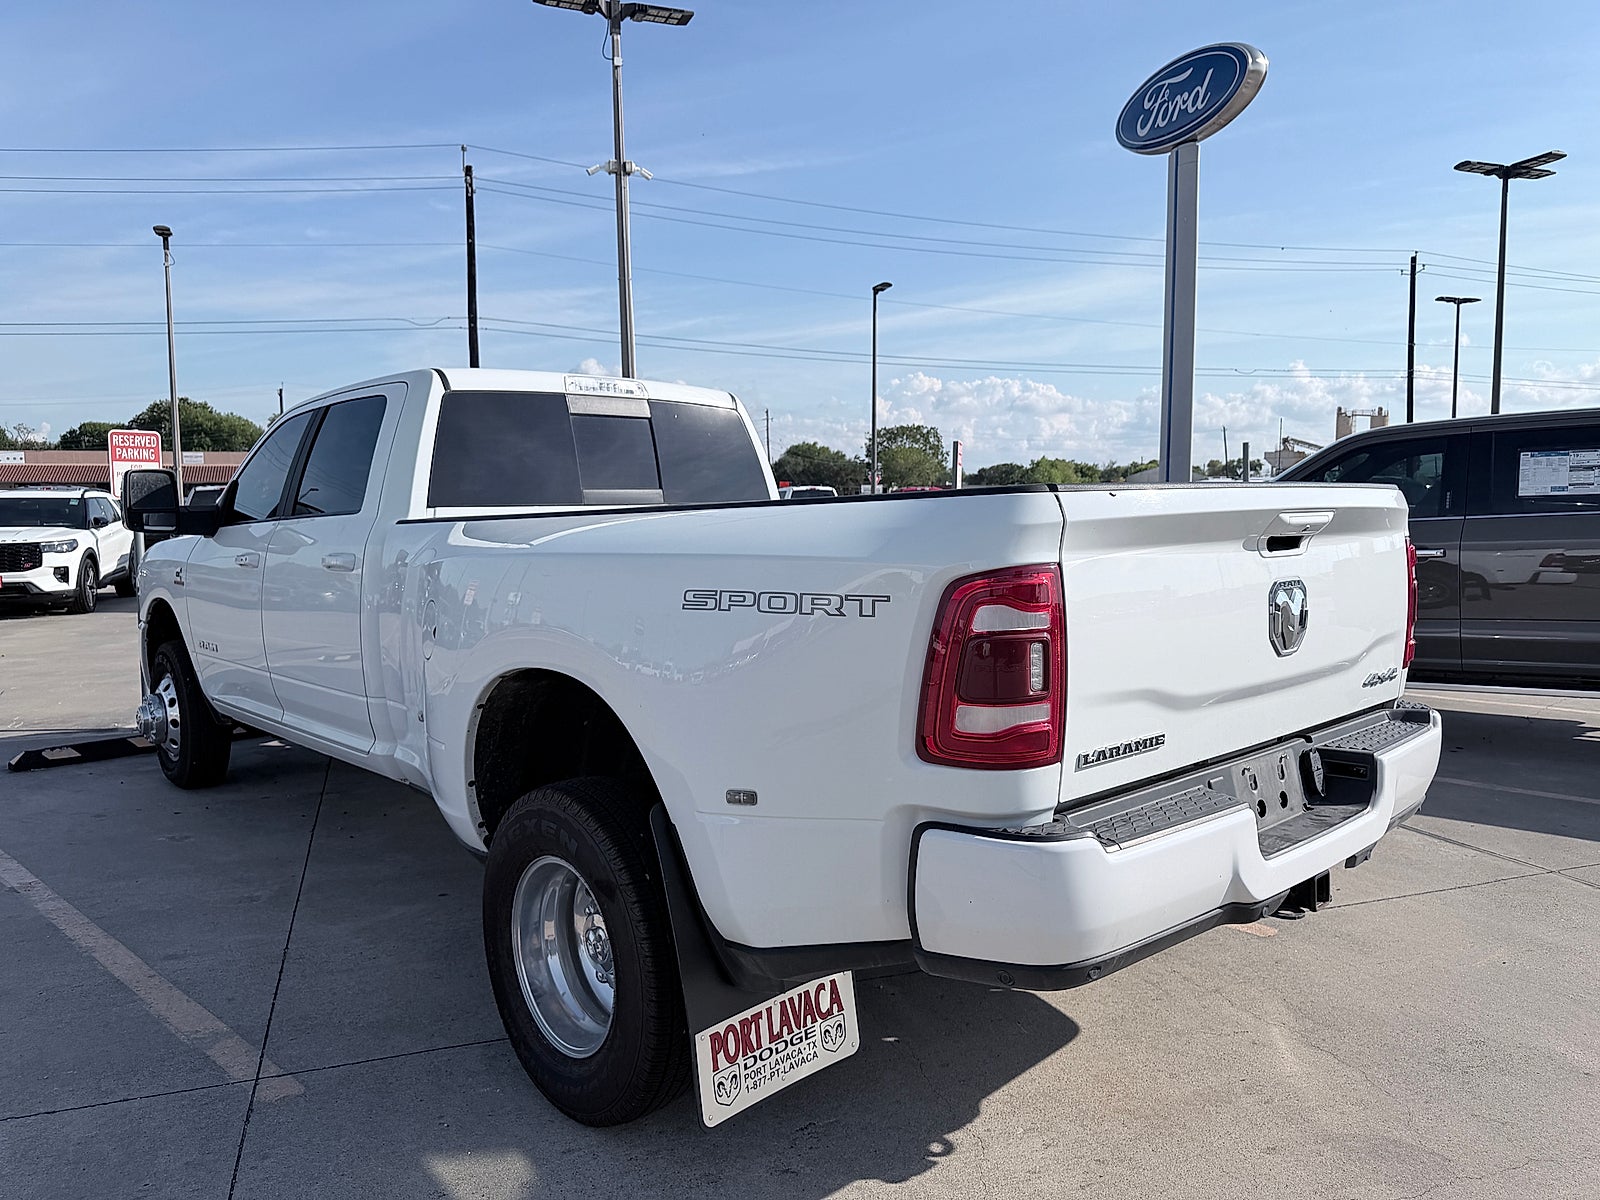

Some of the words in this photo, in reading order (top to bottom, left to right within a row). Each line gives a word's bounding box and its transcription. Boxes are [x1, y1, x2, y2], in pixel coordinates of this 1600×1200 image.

[1136, 66, 1214, 137] Ford
[112, 434, 157, 448] RESERVED
[115, 447, 156, 460] PARKING
[682, 589, 891, 618] SPORT
[1078, 733, 1166, 768] LARAMIE
[708, 1010, 763, 1073] PORT
[765, 978, 845, 1044] LAVACA
[742, 1024, 817, 1071] DODGE
[743, 1063, 767, 1084] PORT
[744, 1050, 819, 1094] 1-877-PT-LAVACA
